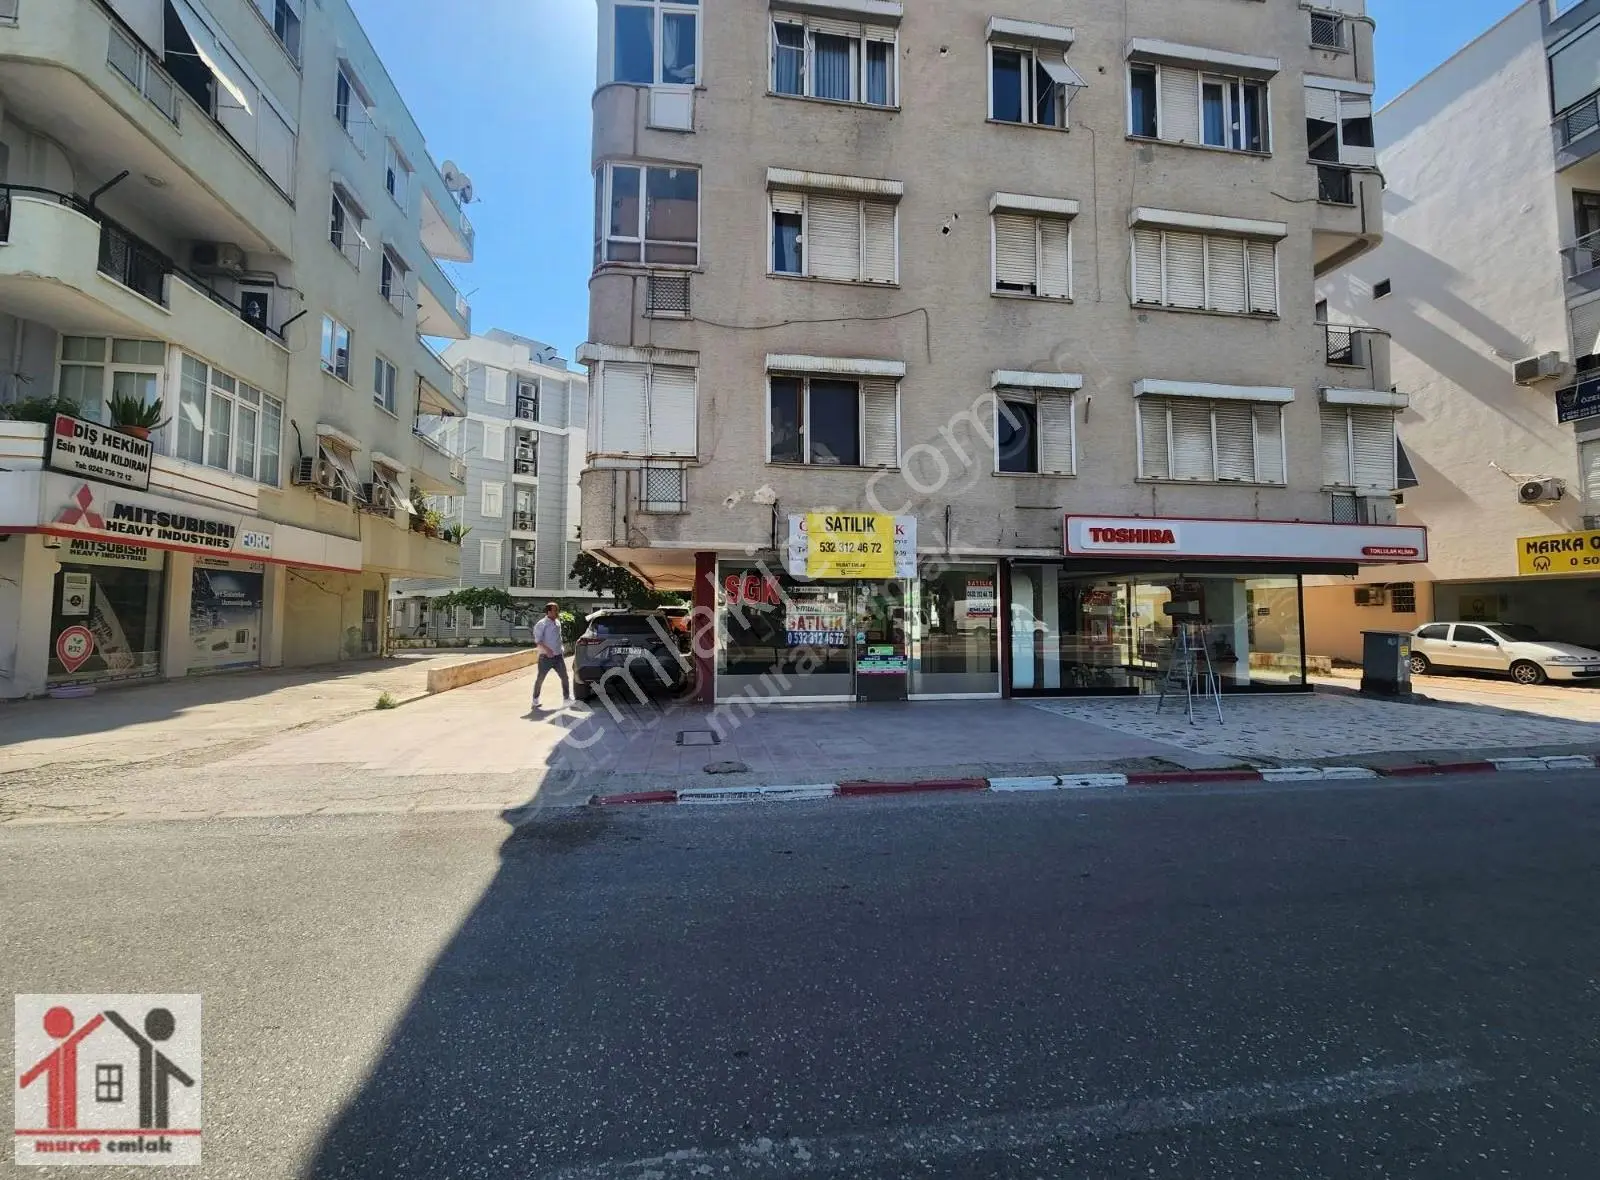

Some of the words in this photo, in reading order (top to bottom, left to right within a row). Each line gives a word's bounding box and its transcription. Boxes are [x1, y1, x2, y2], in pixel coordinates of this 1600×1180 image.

[73, 424, 98, 445] DİŞ
[103, 433, 149, 457] HEKİMİ
[56, 438, 76, 454] Esin
[79, 444, 109, 463] YAMAN
[110, 454, 148, 473] KILDIRAN
[113, 503, 236, 539] MITSUBISHI
[825, 516, 876, 532] SATILIK
[106, 521, 154, 538] HEAVY
[158, 530, 230, 548] INDUSTRIES
[1089, 528, 1175, 543] TOSHIBA
[71, 539, 148, 556] MITSUBISHI
[820, 542, 836, 553] 532
[839, 542, 855, 553] 312
[857, 542, 868, 553] 46
[871, 542, 882, 553] 72
[1526, 538, 1584, 554] MARKA
[70, 549, 99, 557] HEAVY
[102, 552, 147, 561] INDUSTRIES
[1583, 557, 1600, 565] 50
[725, 575, 781, 605] SGK
